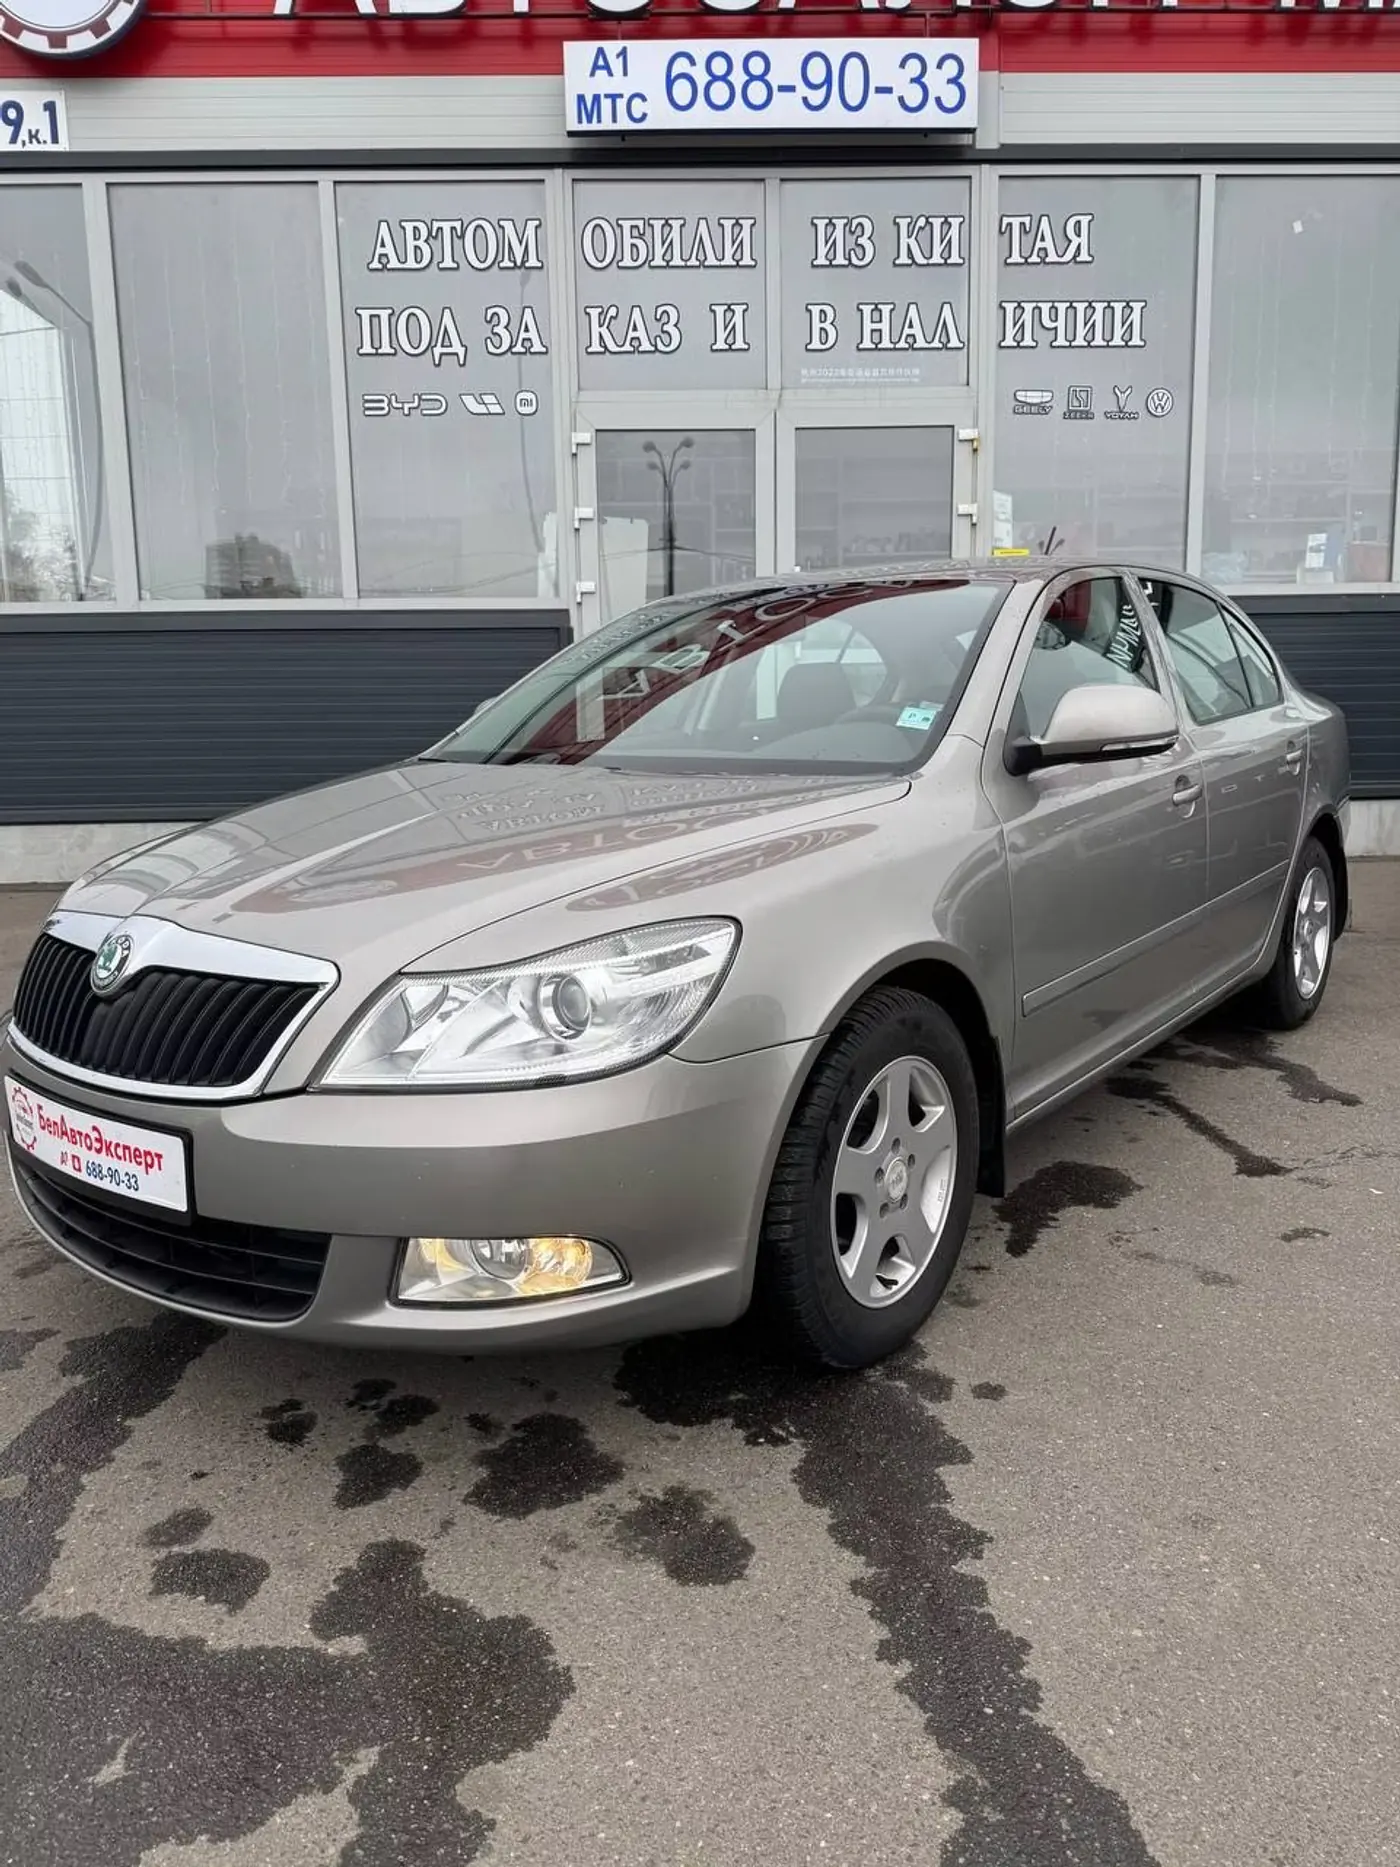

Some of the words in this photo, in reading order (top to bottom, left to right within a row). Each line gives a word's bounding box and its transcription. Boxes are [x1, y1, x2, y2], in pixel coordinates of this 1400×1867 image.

[589, 47, 629, 78] A1
[664, 49, 967, 115] 688-90-33
[0, 99, 60, 149] 9,к.1
[575, 92, 648, 126] МТС
[367, 217, 543, 271] АВТОМ
[581, 216, 757, 270] ОБИЛИ
[811, 214, 876, 269] ИЗ
[893, 214, 965, 267] КИ
[1000, 213, 1094, 266] ТАЯ
[355, 306, 467, 367] ПОД
[485, 304, 548, 356] ЗА
[584, 303, 683, 355] КАЗ
[709, 303, 750, 352] И
[805, 302, 838, 352] В
[856, 301, 966, 351] НАЛ
[998, 299, 1147, 349] ИЧИИ
[37, 1103, 165, 1175] БелАвтоЭксперт
[85, 1160, 140, 1192] 688-90-33
